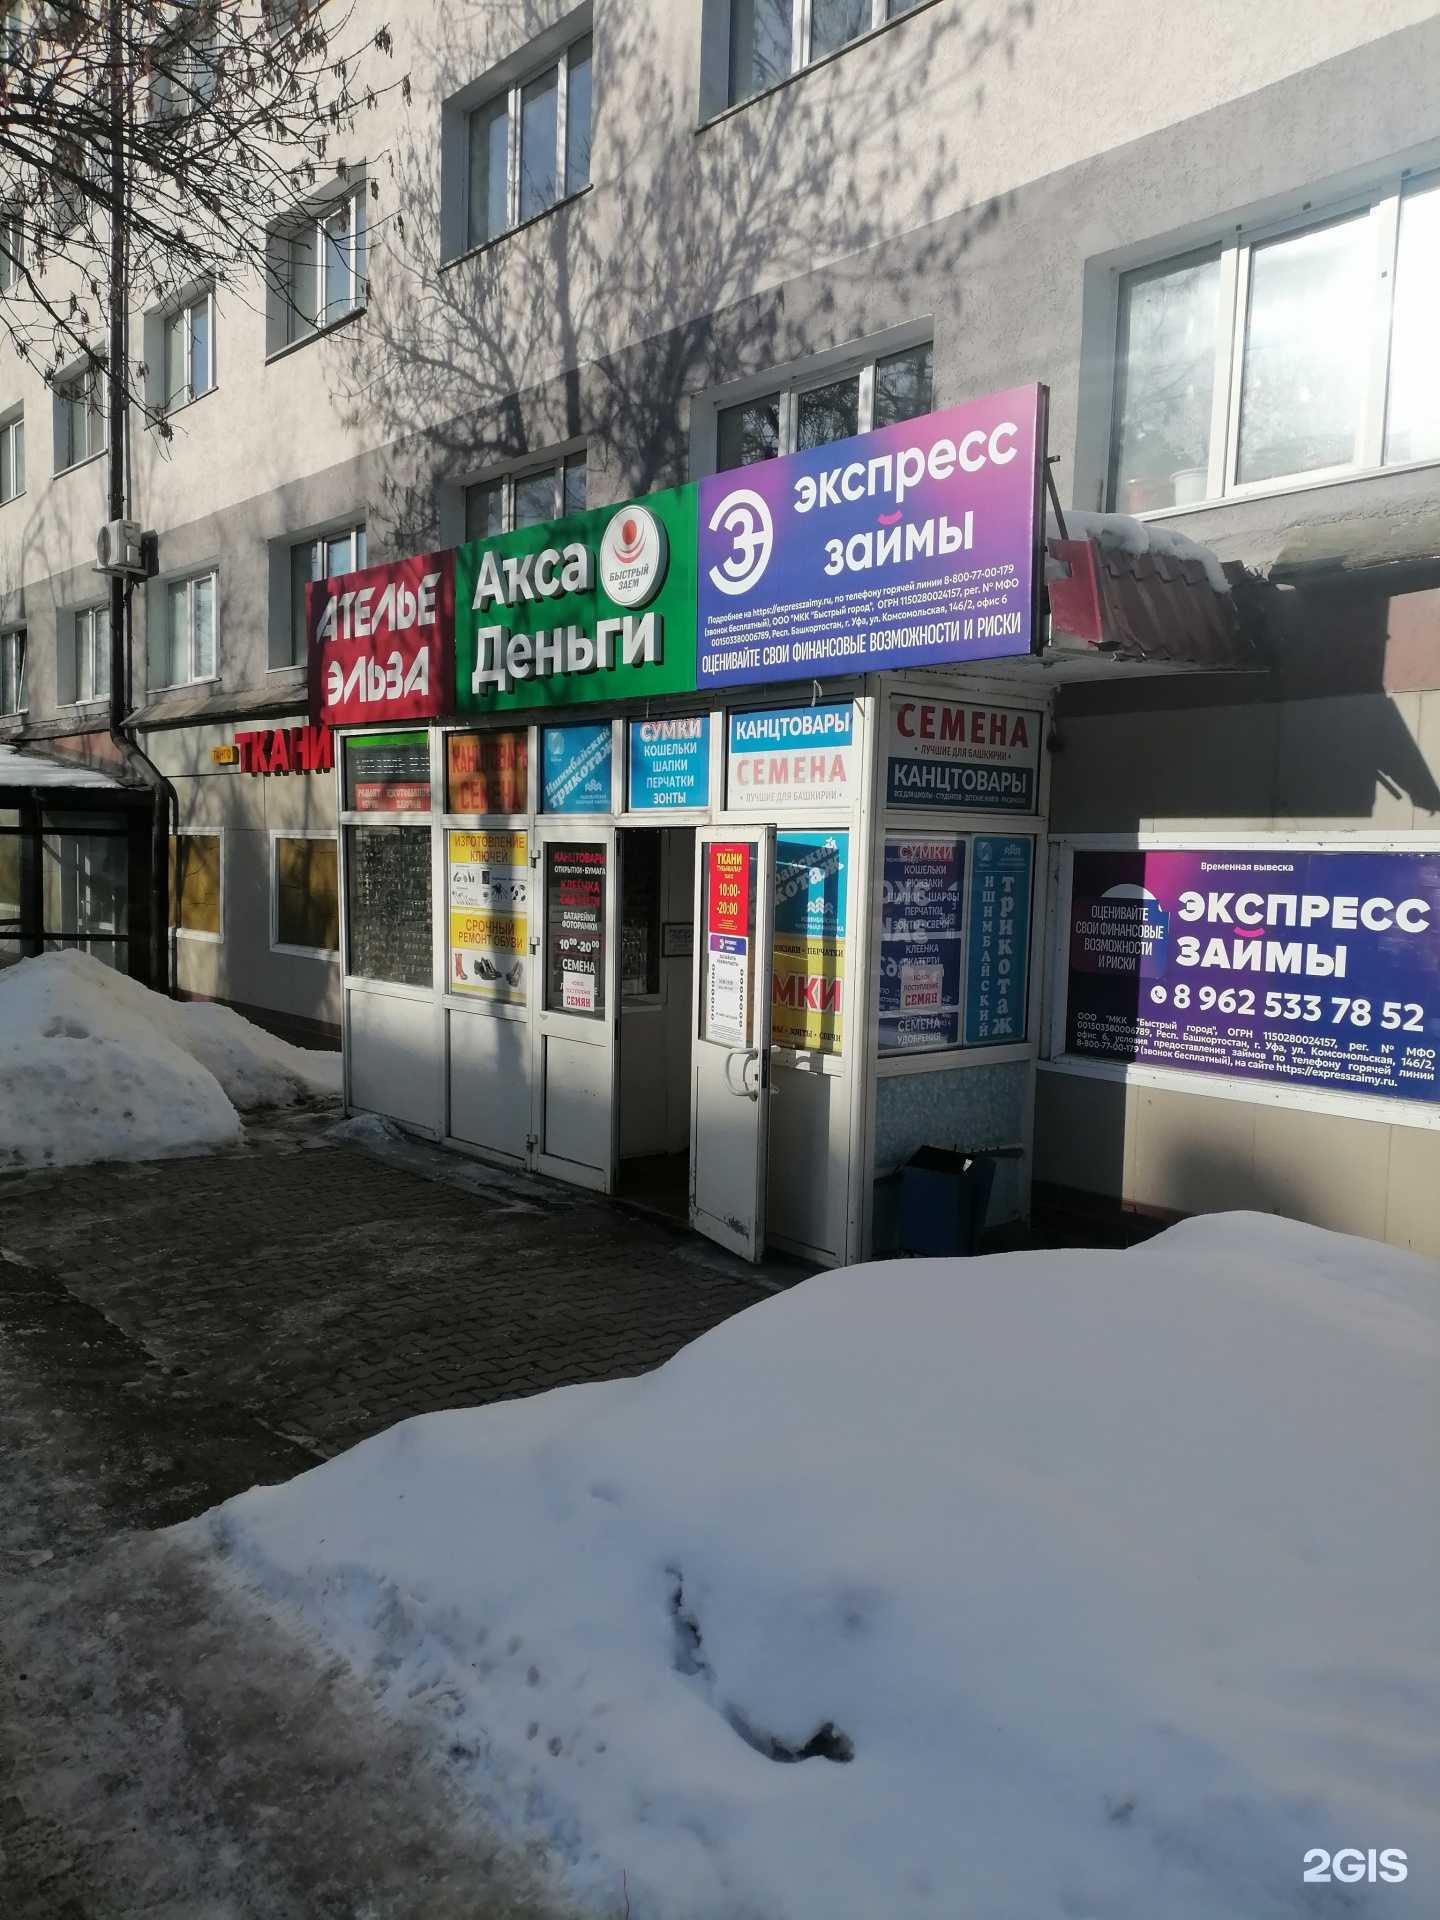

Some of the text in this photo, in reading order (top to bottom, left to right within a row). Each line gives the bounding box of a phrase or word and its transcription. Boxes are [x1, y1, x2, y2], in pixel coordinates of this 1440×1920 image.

[472, 542, 590, 610] Акса
[609, 564, 649, 581] БЫСТРЫЙ
[707, 612, 743, 625] Подробнее
[744, 610, 752, 620] на
[835, 595, 846, 604] по
[847, 586, 882, 601] телефону
[883, 580, 914, 596] горячей
[917, 578, 942, 590] линии
[944, 564, 1014, 585] 8-800-77-00-179
[316, 572, 441, 644] АТЕЛЬЕ
[705, 626, 728, 637] (звонок
[772, 615, 790, 626] ООО
[811, 605, 847, 619] "Быстрый
[878, 596, 899, 609] ОГРН
[964, 586, 981, 598] рег.
[995, 577, 1019, 591] МФО
[772, 627, 790, 639] Респ.
[791, 621, 844, 635] Башкортостан,
[851, 615, 868, 627] Уфа,
[870, 614, 881, 626] ул.
[882, 604, 947, 621] Комсомольская,
[949, 599, 975, 613] 146/2,
[976, 596, 999, 608] офис
[1001, 594, 1008, 604] 6
[702, 611, 1021, 675] ОЦЕНИВАЙТЕ СВОИ ФИНАНСОВЫЕ ВОЗМОЖНОСТИ И РИСКИ
[472, 612, 656, 694] Деньги
[327, 646, 429, 706] ЭЛЬЗА
[639, 718, 701, 742] СУМКИ
[736, 712, 849, 741] КАНЦТОВАРЫ
[897, 703, 1029, 748] СЕМЕНА
[235, 725, 334, 773] ТКАНИ
[644, 742, 697, 758] КОШЕЛЬКИ
[921, 744, 1007, 760] ЛУЧШИЕ ДЛЯ БАШКИРИИ
[653, 759, 688, 773] ШАПКИ
[736, 753, 847, 785] СЕМЕНА
[646, 774, 694, 789] ПЕРЧАТКИ
[894, 763, 1027, 793] КАНЦТОВАРЫ
[653, 792, 687, 804] ЗОНТЫ
[745, 790, 837, 804] ЛУЧШИЕ ДЛЯ БАШКИРИИ
[455, 835, 525, 849] ИЗГОТОВЛЕНИЕ
[470, 849, 508, 863] КЛЮЧЕЙ
[716, 853, 743, 866] ТКАНИ
[898, 843, 953, 862] СУМКИ
[904, 865, 947, 875] КОШЕЛЬКИ
[1200, 861, 1294, 873] Временная вывеска
[928, 891, 960, 902] ШАРФЫ
[563, 911, 596, 922] БАТАРЕЙКИ
[904, 906, 943, 916] ПЕРЧАТКИ
[1091, 905, 1149, 921] ОЦЕНИВАЙТЕ
[1177, 890, 1431, 933] ЭКСПРЕСС
[466, 918, 515, 934] СРОЧНЫЙ
[561, 920, 598, 931] ФОТОРАМКИ
[1076, 921, 1164, 940] СВОИ ФИНАНСОВЫЕ
[458, 931, 523, 949] РЕМОНТ ОБУВИ
[905, 943, 939, 954] КЛЕЕНКА
[1084, 938, 1153, 956] ВОЗМОЖНОСТИ
[562, 958, 596, 974] СЕМЕНА
[1098, 955, 1136, 970] И РИСКИ
[566, 996, 591, 1008] СЕМЯН
[905, 992, 938, 1006] СЕМЯН
[1173, 983, 1425, 1032] 8 962 533 78 52
[897, 1018, 940, 1032] СЕМЕНА
[1077, 1012, 1097, 1021] ООО
[1136, 1017, 1178, 1030] "Быстрый
[1186, 1024, 1218, 1036] город",
[1227, 1027, 1253, 1038] ОГРН
[1263, 1031, 1338, 1049] 1150280024157,
[1349, 1042, 1369, 1052] рег.
[1406, 1047, 1436, 1059] МФО
[1077, 1031, 1097, 1040] офис
[1115, 1035, 1148, 1045] условия
[1153, 1040, 1226, 1055] предоставления
[1232, 1048, 1266, 1060] займов
[1273, 1053, 1286, 1062] по
[1292, 1055, 1341, 1070] телефону
[1348, 1063, 1392, 1075] горячей
[1399, 1069, 1435, 1080] линии
[1156, 1030, 1179, 1040] Респ.
[1183, 1033, 1250, 1049] Башкортостан,
[1265, 1043, 1287, 1054] Уфа,
[1291, 1046, 1306, 1056] ул.
[1311, 1047, 1396, 1066] Комсомольская,
[1401, 1057, 1435, 1071] 146/2,
[1140, 1045, 1173, 1058] (звонок
[1174, 1051, 1233, 1067] бесплатный),
[1235, 1060, 1247, 1068] на
[1248, 1060, 1274, 1071] сайте
[1276, 1063, 1398, 1087] https://expresszaimy.ru.
